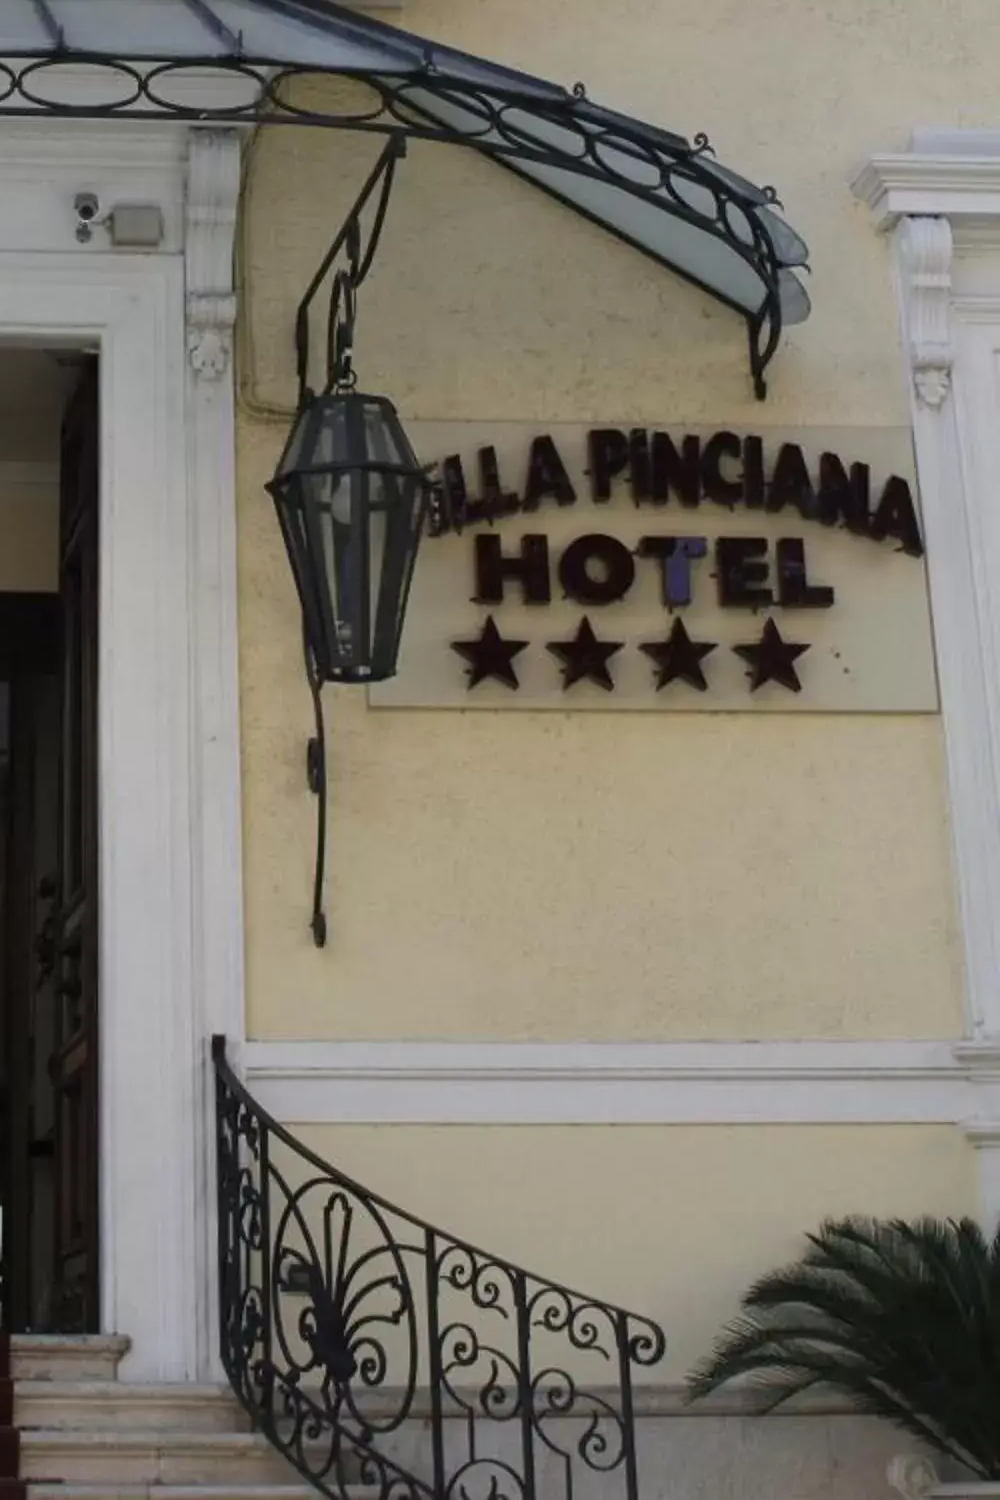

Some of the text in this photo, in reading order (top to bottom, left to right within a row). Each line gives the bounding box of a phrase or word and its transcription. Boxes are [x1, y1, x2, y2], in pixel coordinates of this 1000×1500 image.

[426, 428, 925, 558] ILLA PINCIANA
[473, 532, 835, 609] HOTEL
